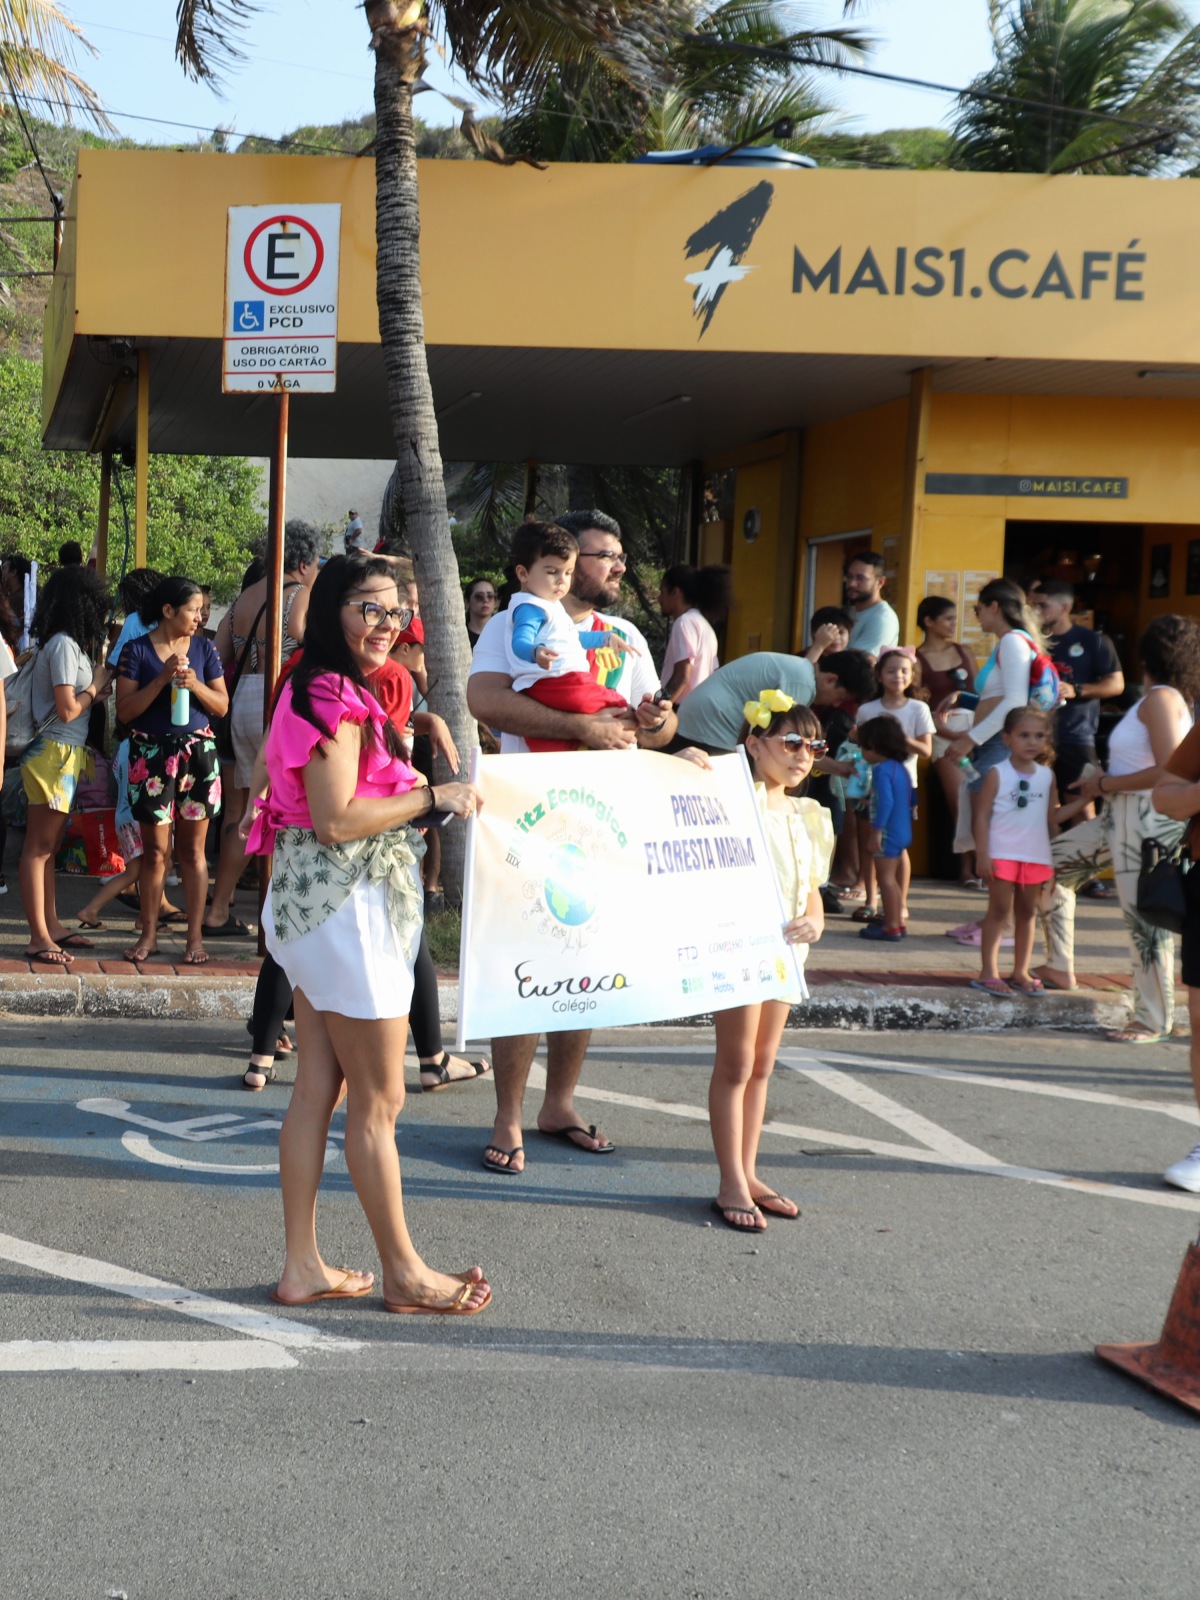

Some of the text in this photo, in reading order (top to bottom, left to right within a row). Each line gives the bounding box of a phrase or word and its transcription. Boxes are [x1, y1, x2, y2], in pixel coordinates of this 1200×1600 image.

[266, 233, 301, 280] E
[791, 239, 1147, 301] MAIS1.CAFÉ
[269, 304, 335, 314] EXCLUSIVO
[269, 317, 304, 328] PCD
[240, 344, 320, 355] OBRIGATÓRIO
[233, 356, 327, 367] USO DO CARTÃO
[267, 379, 301, 389] VAGA
[546, 786, 628, 849] Ecológica
[670, 795, 723, 827] PROTEJA
[644, 837, 716, 875] FLORESTA
[678, 946, 699, 961] FTD
[514, 960, 632, 999] Eureca
[712, 970, 726, 980] Meu
[552, 998, 597, 1014] Colégio
